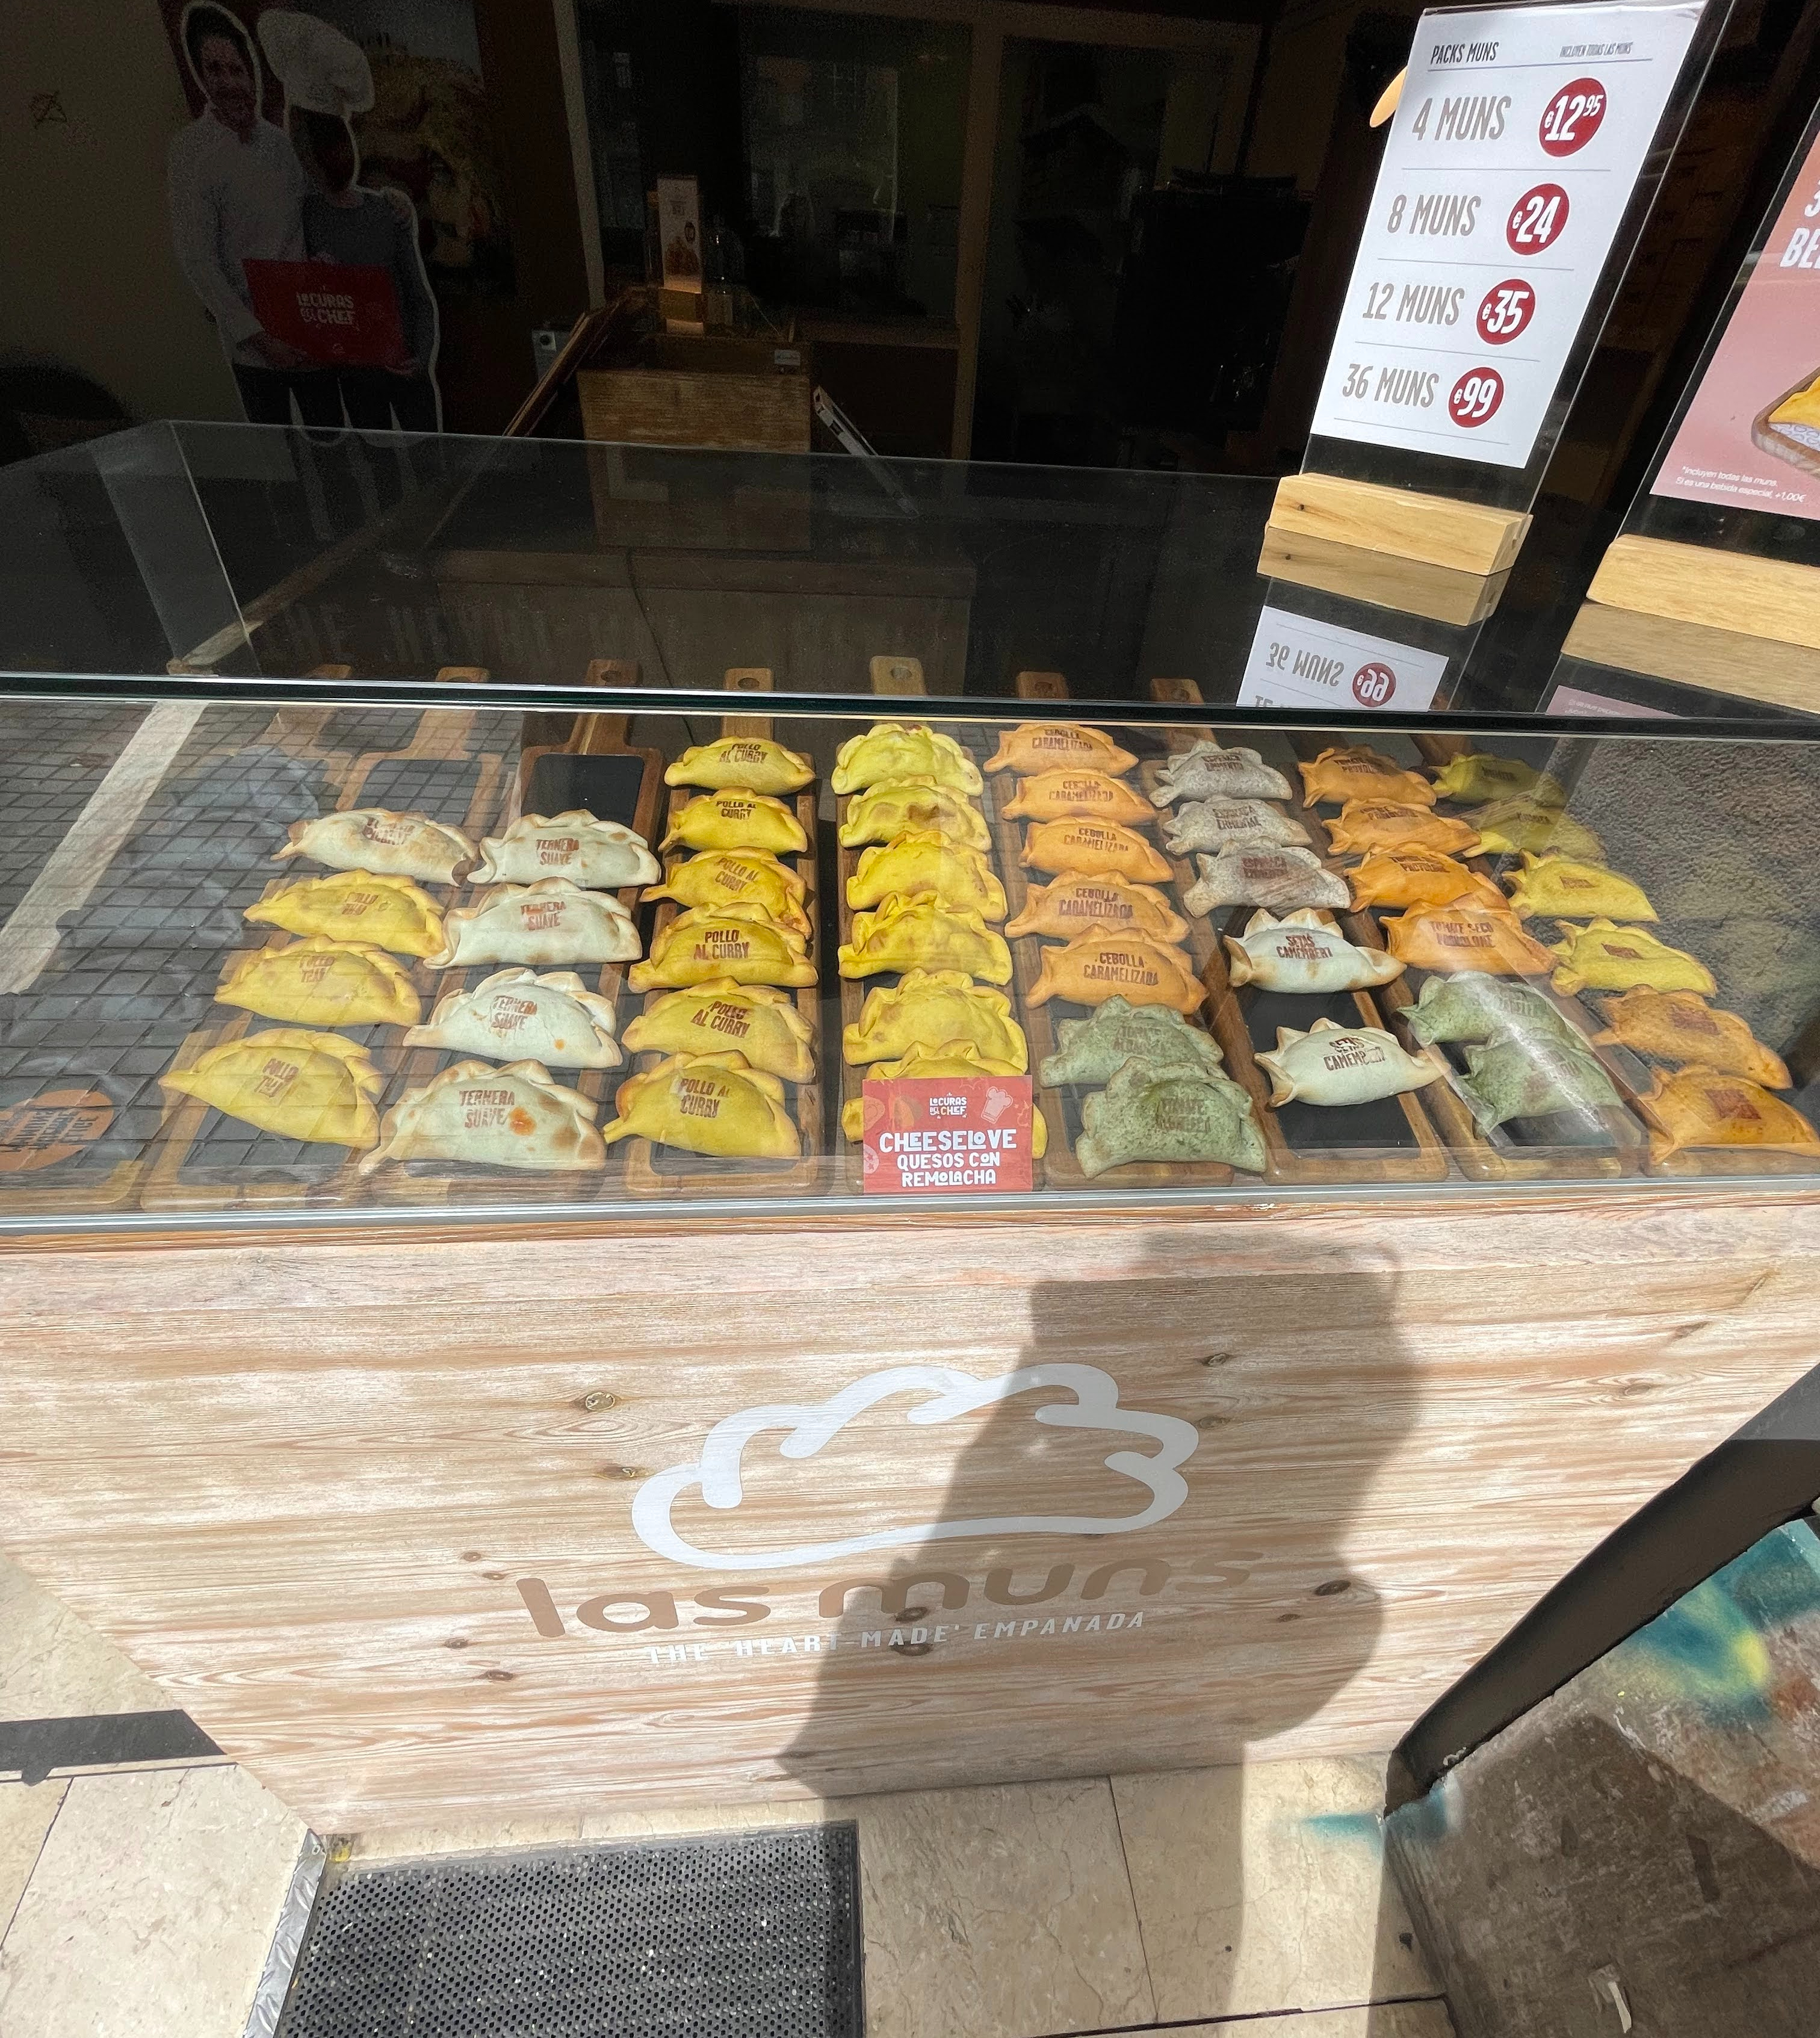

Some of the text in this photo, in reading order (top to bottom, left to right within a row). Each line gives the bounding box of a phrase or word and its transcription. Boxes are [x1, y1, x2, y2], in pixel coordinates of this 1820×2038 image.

[1430, 42, 1499, 64] PACKS MUNS
[1412, 97, 1433, 141] 4
[1434, 96, 1512, 141] MUNS
[1387, 193, 1407, 235] 8
[1409, 194, 1482, 237] MUNS
[1780, 227, 1820, 269] BE
[1362, 282, 1394, 320] 12
[1396, 283, 1466, 326] MUNS
[317, 309, 355, 326] CHEF
[1342, 363, 1373, 399] 36
[1374, 367, 1440, 408] MUNS
[719, 751, 768, 764] AL CURRY
[721, 808, 752, 820] CURRY
[717, 857, 760, 882] POLLO AL
[714, 870, 748, 891] CURRY
[1076, 888, 1119, 903] CEBOLLA
[1058, 899, 1134, 920] CARAMELIZADA
[705, 929, 740, 943] POLLO
[1286, 934, 1316, 948] SETAS
[693, 941, 750, 960] AL CURRY
[1100, 952, 1145, 968] CEBOLLA
[1083, 964, 1159, 986] CARAMELIZADA
[710, 1000, 748, 1020] POLLO
[690, 1009, 751, 1039] AL CURRY
[1329, 1036, 1365, 1053] SETAS
[459, 1089, 515, 1106] TERNERA
[681, 1078, 729, 1098] POLLO AL
[680, 1095, 720, 1118] CURRY
[940, 1106, 967, 1115] CHEF
[897, 1151, 1000, 1171] QUESOS CON
[902, 1168, 997, 1188] REMOLACHA
[516, 1550, 1263, 1637] las muns
[643, 1644, 709, 1664] THE
[974, 1611, 1144, 1640] EMPANADA
